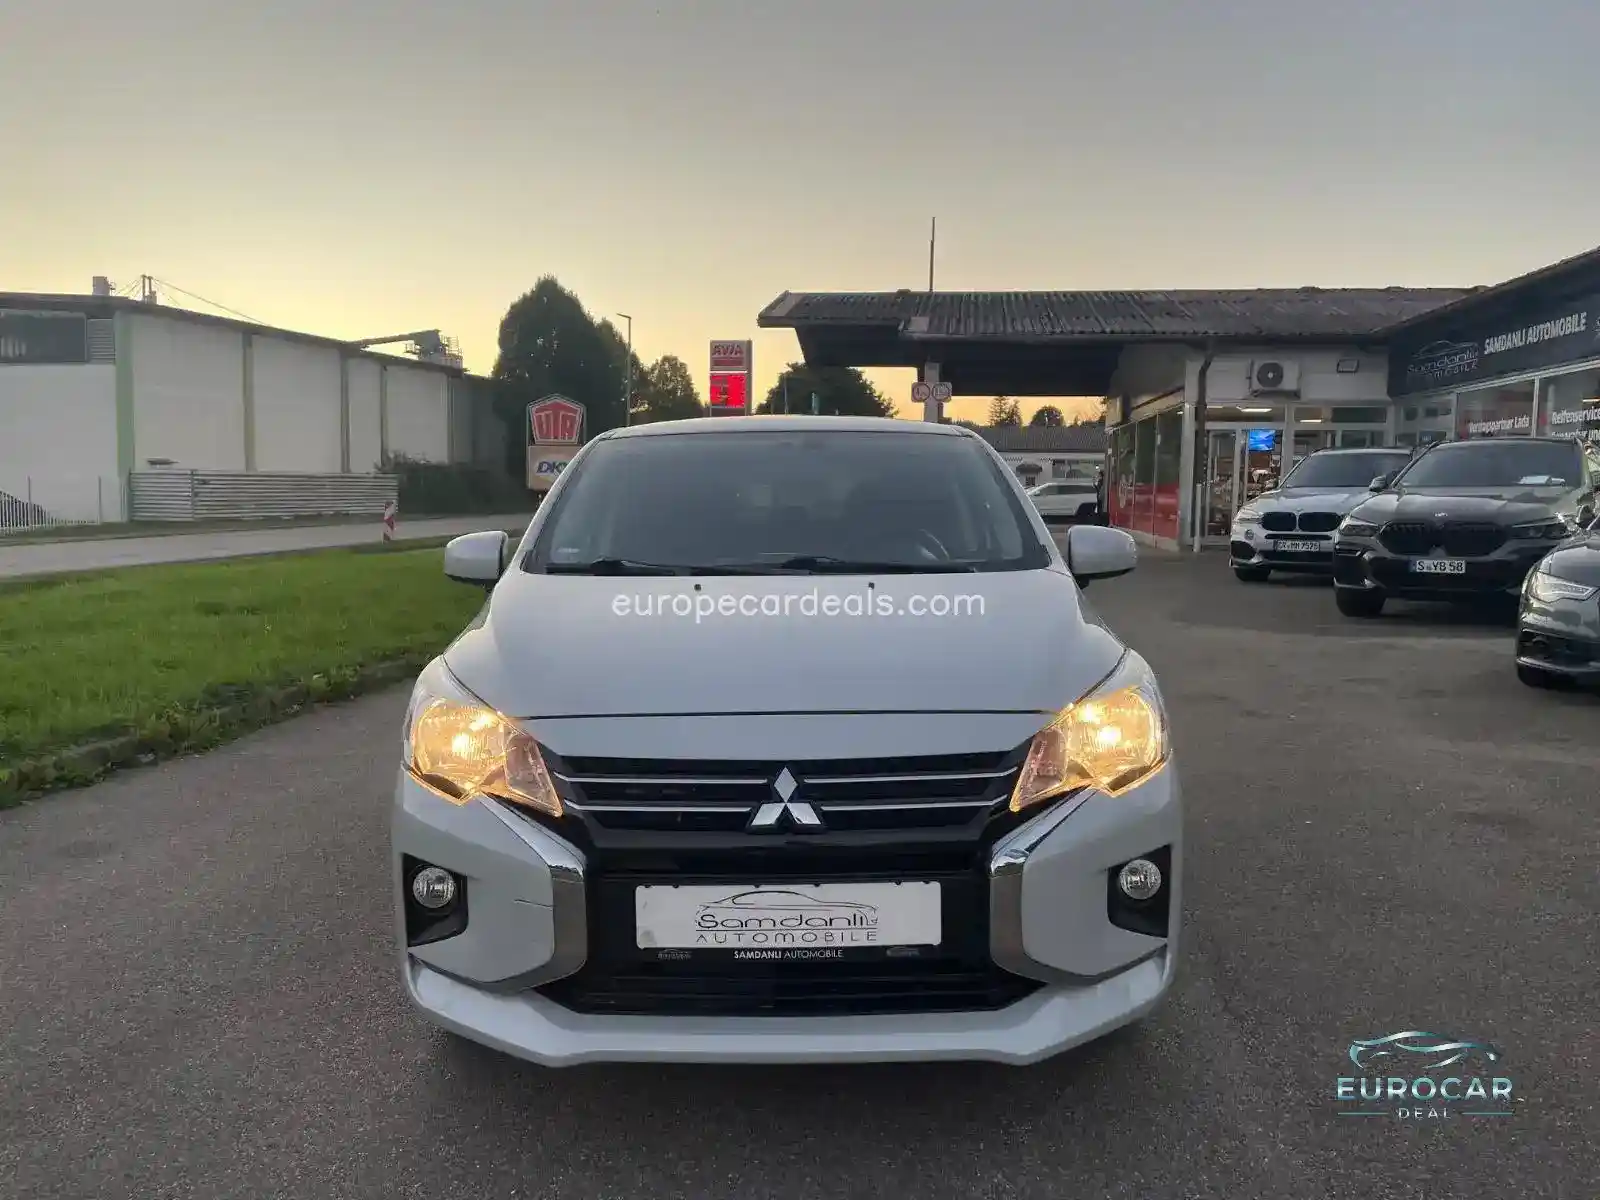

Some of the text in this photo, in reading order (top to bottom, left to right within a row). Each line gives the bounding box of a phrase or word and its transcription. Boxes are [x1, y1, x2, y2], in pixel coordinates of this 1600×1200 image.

[1484, 328, 1526, 355] SAMDANLI
[1526, 312, 1587, 343] AUTOMOBILE
[536, 461, 567, 474] DK
[1432, 560, 1446, 571] YB
[1449, 561, 1463, 572] 58
[697, 913, 864, 928] Samdanli
[696, 931, 877, 944] AUTOMOBILE
[734, 949, 844, 960] SAMDANLI AUTOMOBILE
